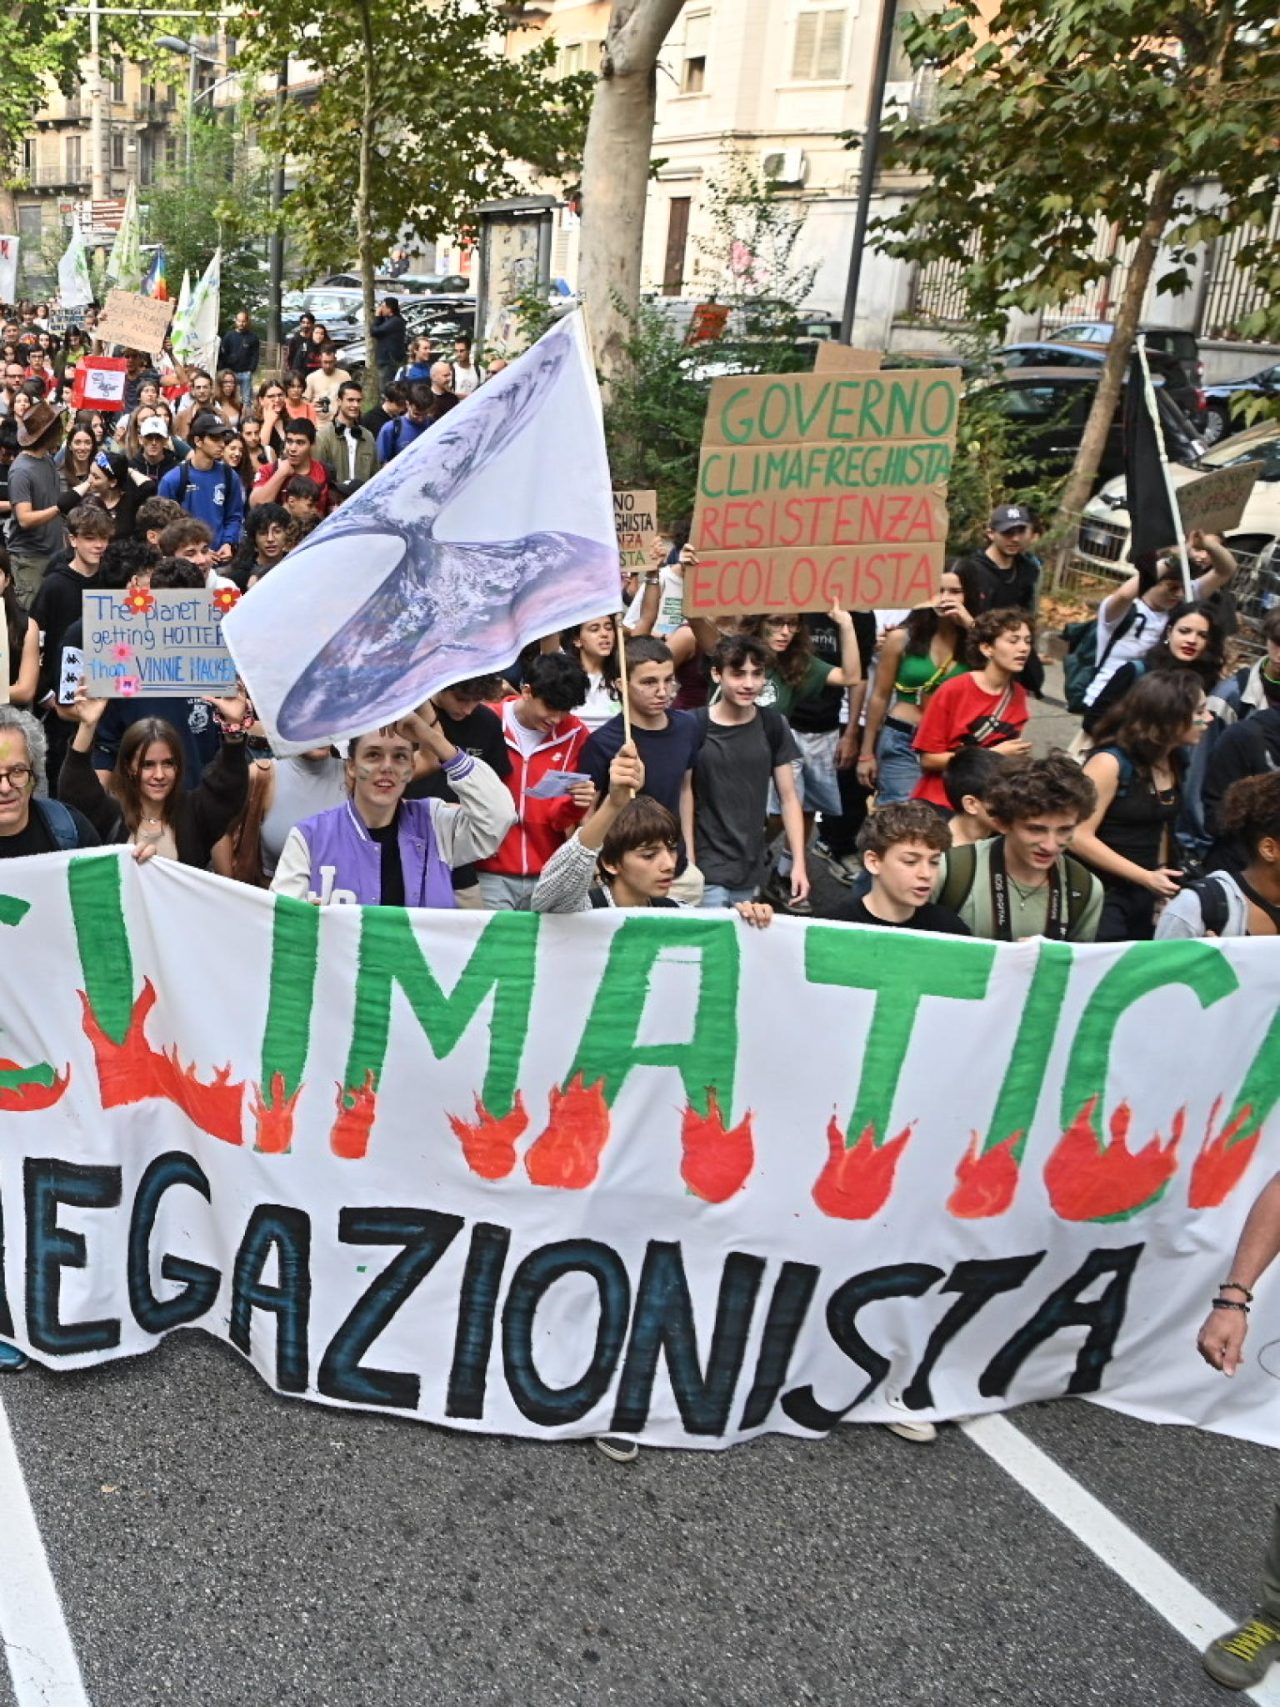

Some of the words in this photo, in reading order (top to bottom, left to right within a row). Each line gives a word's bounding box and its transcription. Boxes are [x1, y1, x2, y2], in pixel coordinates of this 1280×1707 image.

[721, 378, 956, 445] GOVERNO
[699, 443, 953, 499] CLIMAFREGHISTA
[698, 494, 937, 549] RESISTENZA
[692, 552, 938, 609] ECOLOGISTA
[86, 595, 134, 623] The
[143, 599, 201, 632] planet
[90, 626, 157, 654] getting
[87, 660, 127, 681] than
[135, 655, 186, 683] VINNIE
